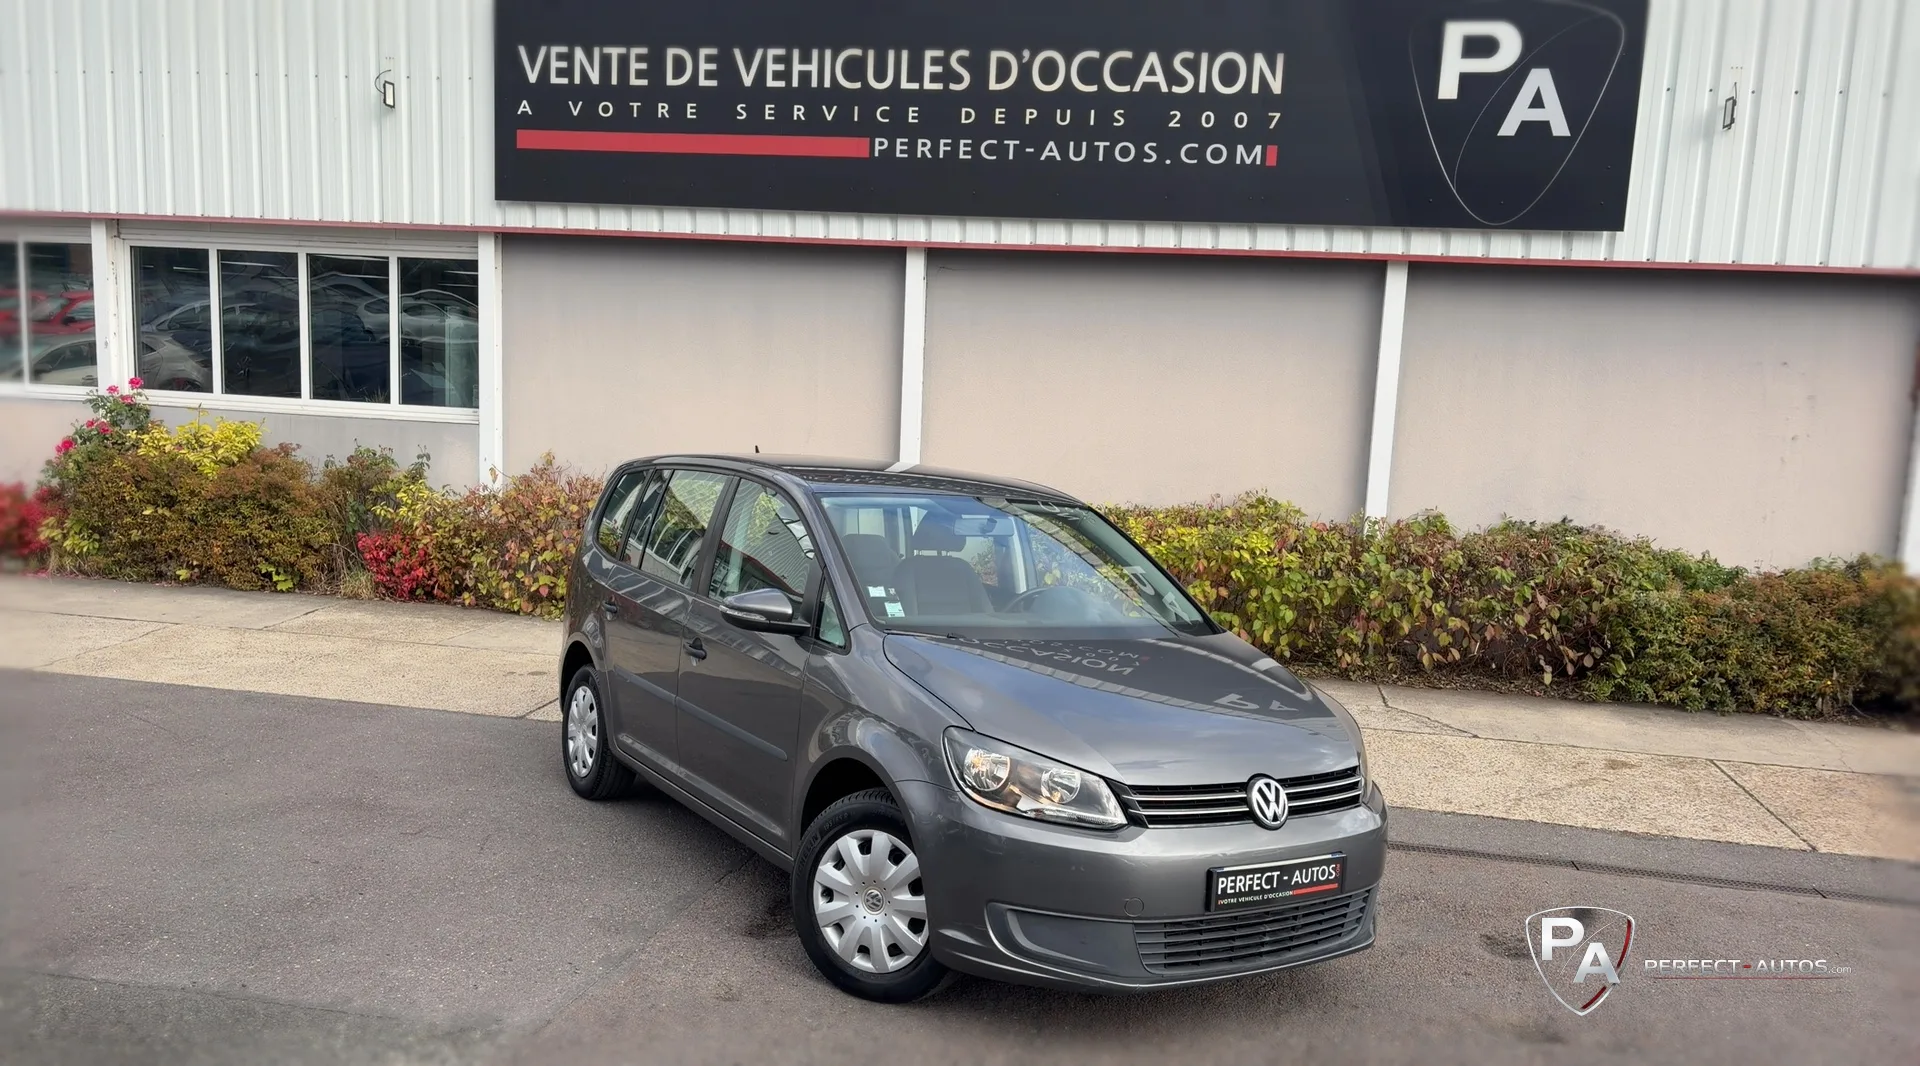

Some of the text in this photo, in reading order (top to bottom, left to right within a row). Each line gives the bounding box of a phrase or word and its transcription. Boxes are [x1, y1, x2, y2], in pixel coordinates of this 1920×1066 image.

[517, 45, 1285, 94] VENTE DE VEHICULES D'OCCASION
[516, 99, 1281, 129] A VOTRE SERVICE DEPUIS 2007
[1217, 871, 1280, 895] PERFECT
[1291, 864, 1336, 886] AUTOS
